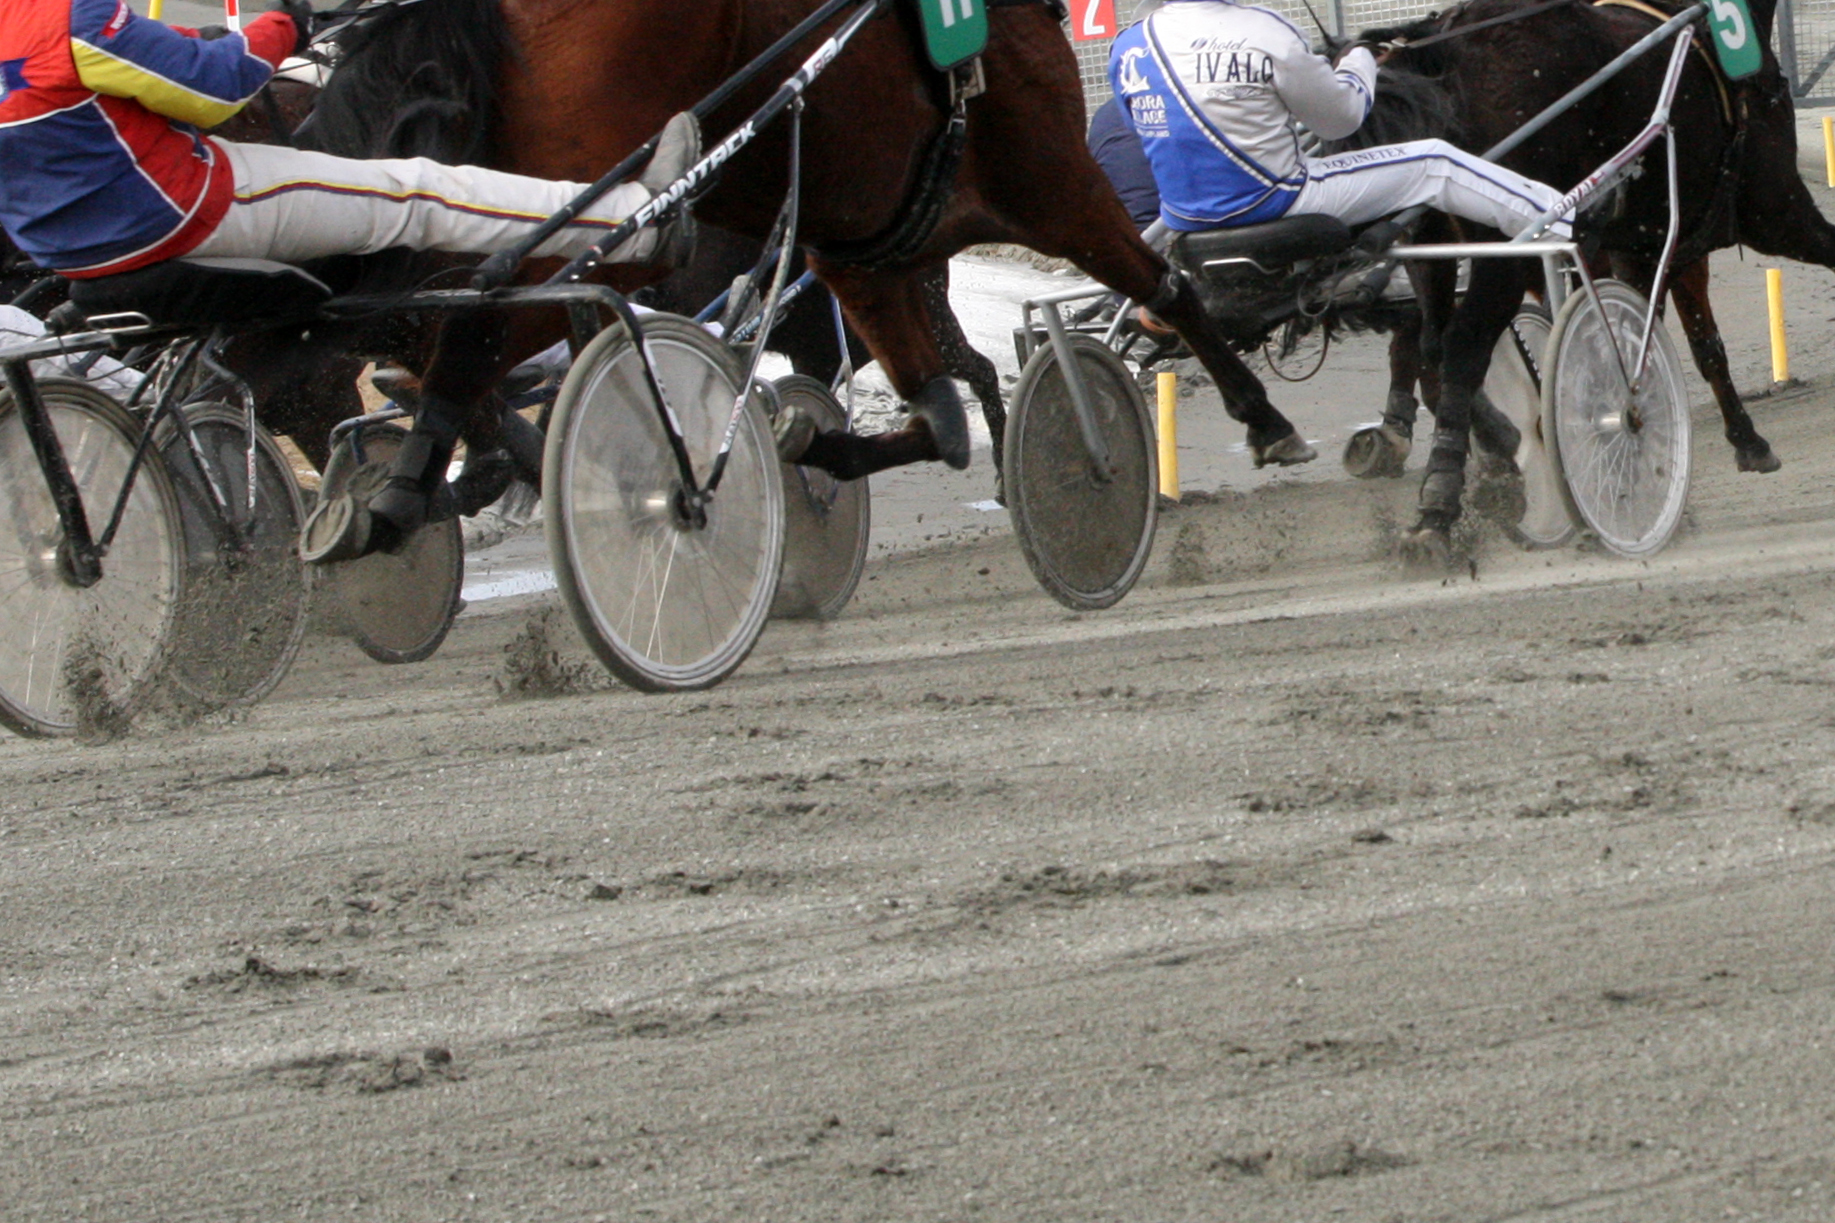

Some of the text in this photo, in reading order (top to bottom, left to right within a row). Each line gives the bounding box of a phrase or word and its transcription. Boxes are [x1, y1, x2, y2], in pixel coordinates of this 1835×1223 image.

[1208, 36, 1249, 51] hotel
[1195, 52, 1274, 84] IVALO
[1323, 146, 1408, 170] EQUINETEX
[635, 120, 756, 228] FINNTACK
